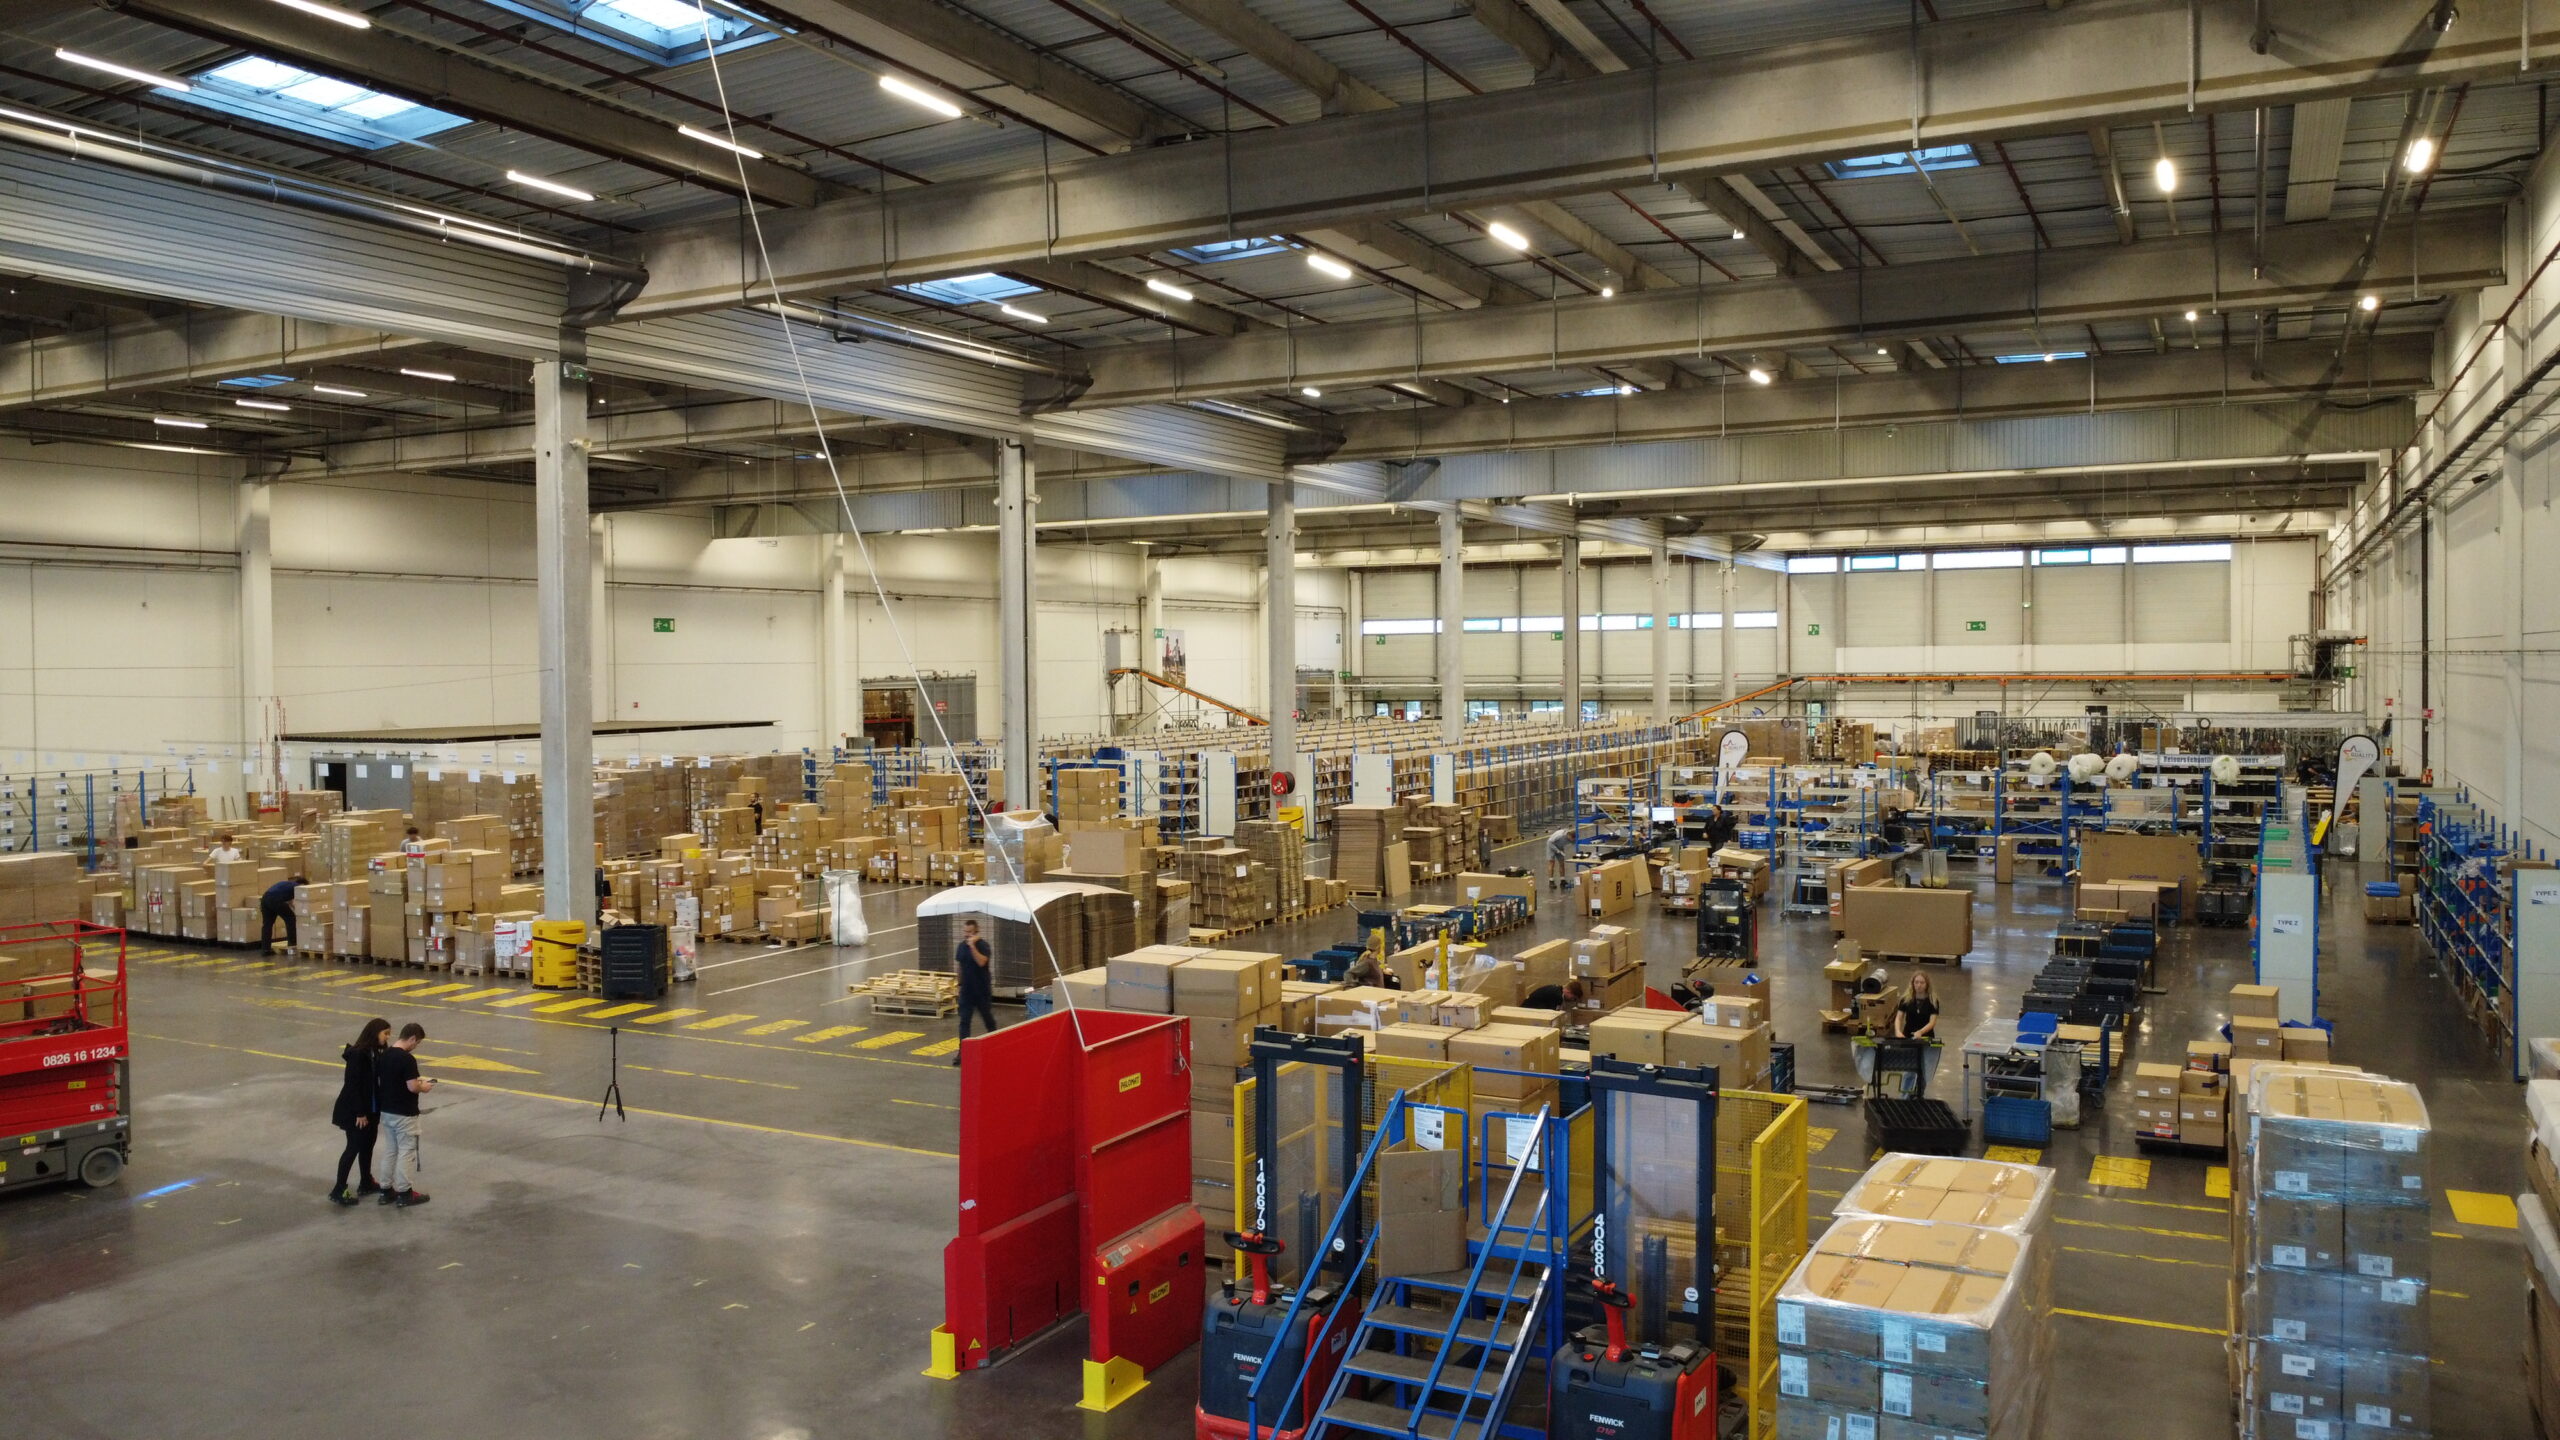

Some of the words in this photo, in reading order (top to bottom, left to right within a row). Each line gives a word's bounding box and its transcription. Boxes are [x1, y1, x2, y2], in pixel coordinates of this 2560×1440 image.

[43, 1053, 71, 1067] 0826
[73, 1050, 88, 1062] 16
[90, 1046, 116, 1059] 1234
[1256, 1158, 1266, 1231] 140679
[1233, 1352, 1263, 1365] FENWICK
[1589, 1413, 1625, 1428] FENWICK
[1596, 1426, 1616, 1436] D12
